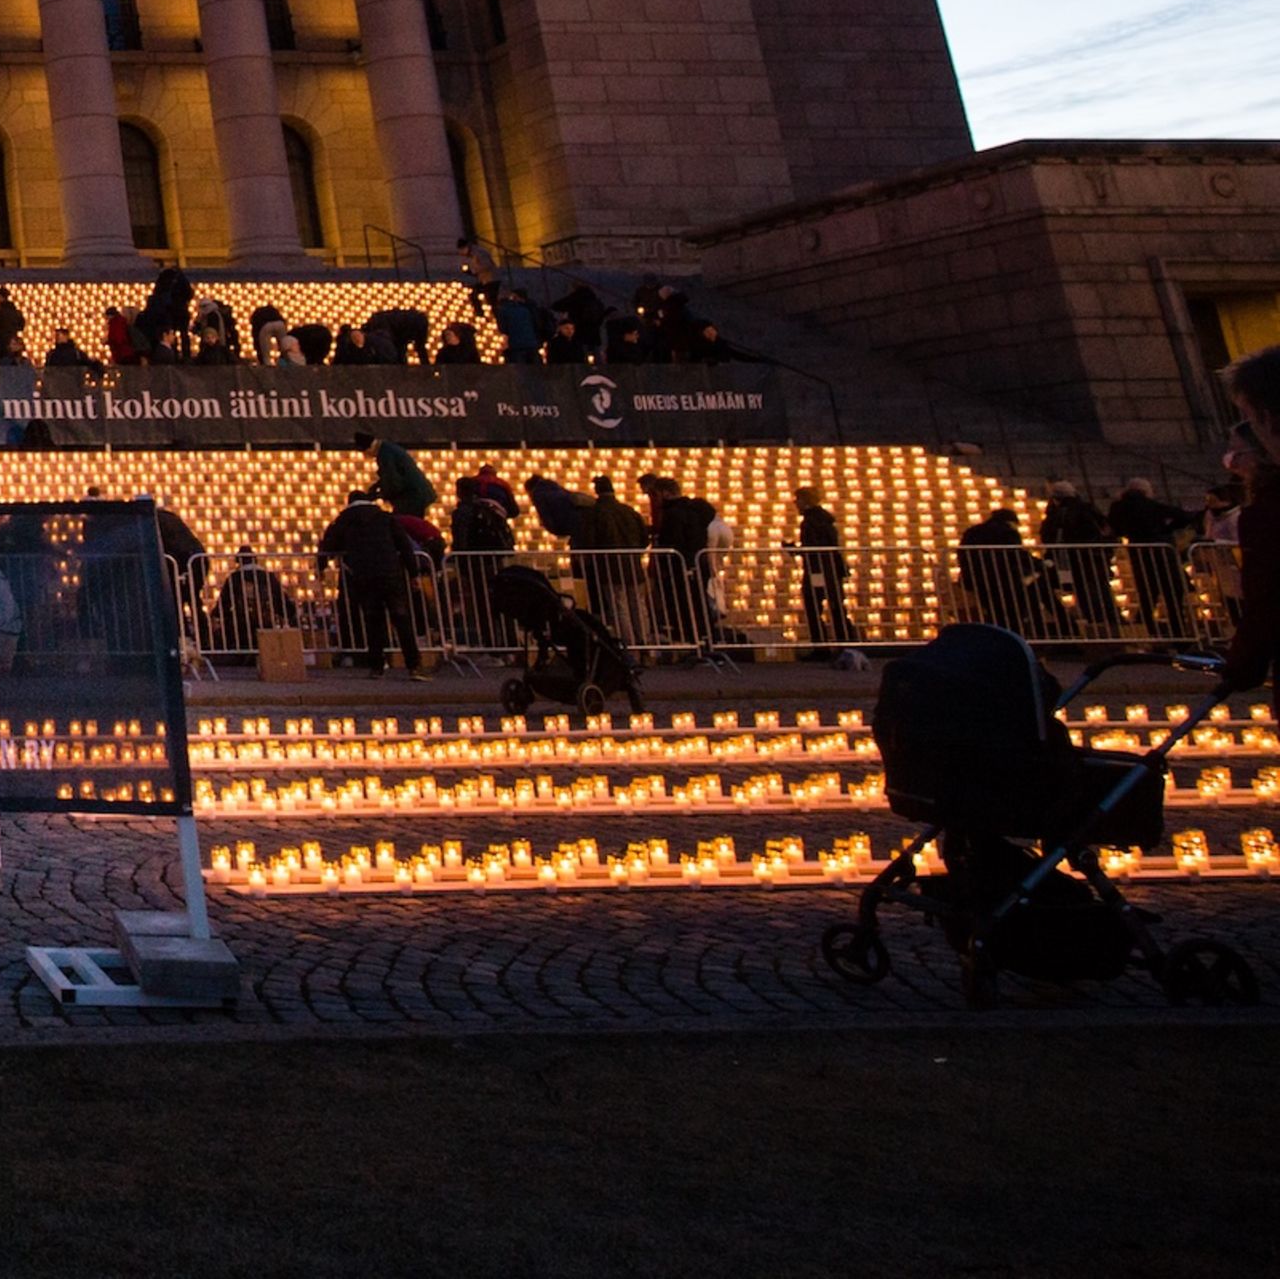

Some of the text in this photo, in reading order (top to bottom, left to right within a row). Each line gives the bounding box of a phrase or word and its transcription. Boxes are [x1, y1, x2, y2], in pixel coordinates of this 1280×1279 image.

[2, 391, 97, 420] minut
[105, 390, 222, 419] kokoon
[229, 389, 312, 419] äitini
[497, 402, 520, 417] Ps.
[633, 391, 763, 412] OIKEUS ELÄMÄÄN RY
[25, 739, 56, 770] RY
